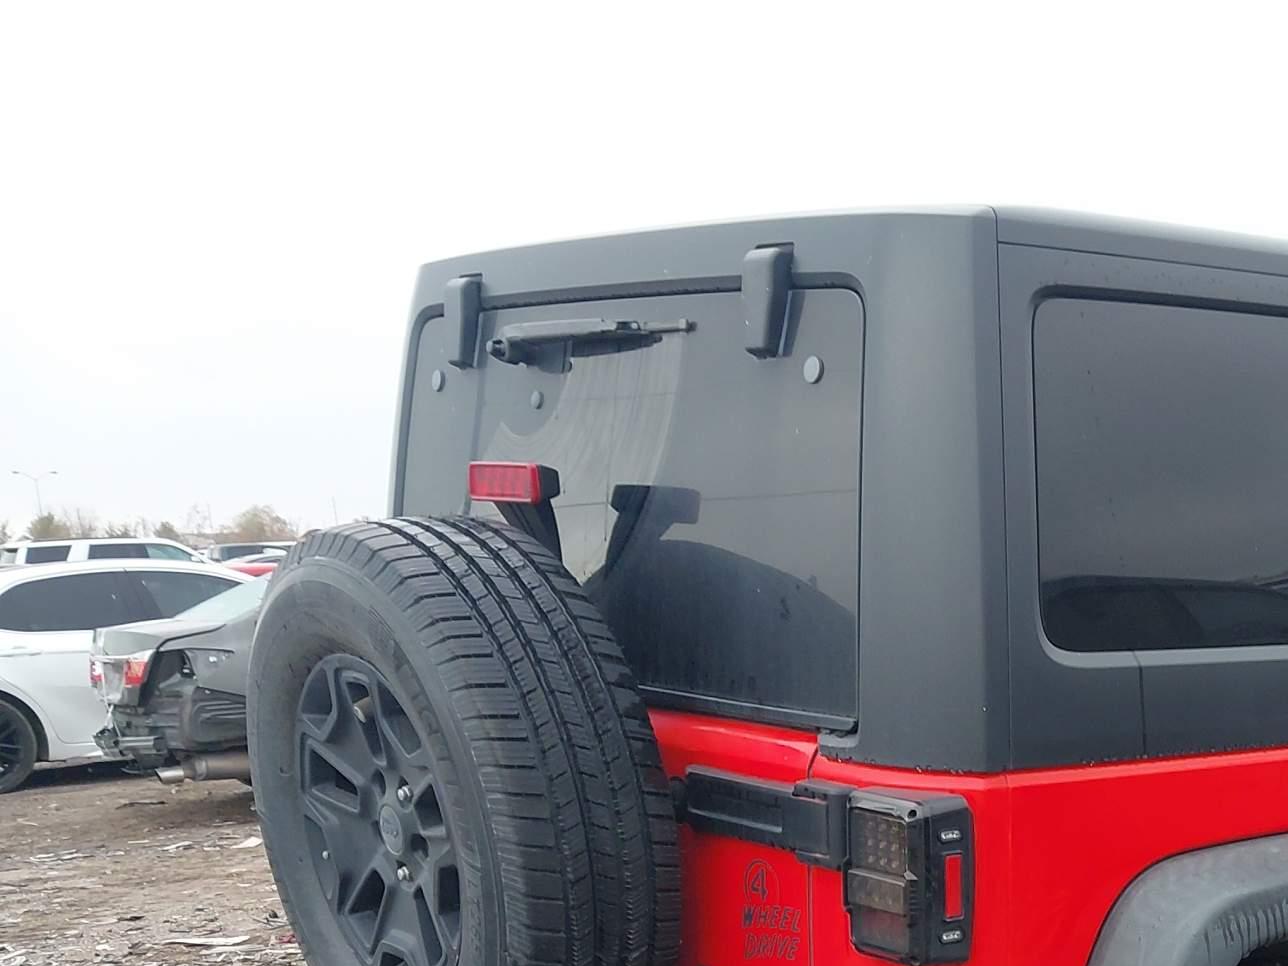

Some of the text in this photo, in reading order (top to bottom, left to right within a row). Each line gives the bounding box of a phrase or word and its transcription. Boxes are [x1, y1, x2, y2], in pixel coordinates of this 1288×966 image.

[750, 866, 768, 902] 4
[742, 904, 801, 933] WHEEL
[743, 934, 801, 960] DRIVE
